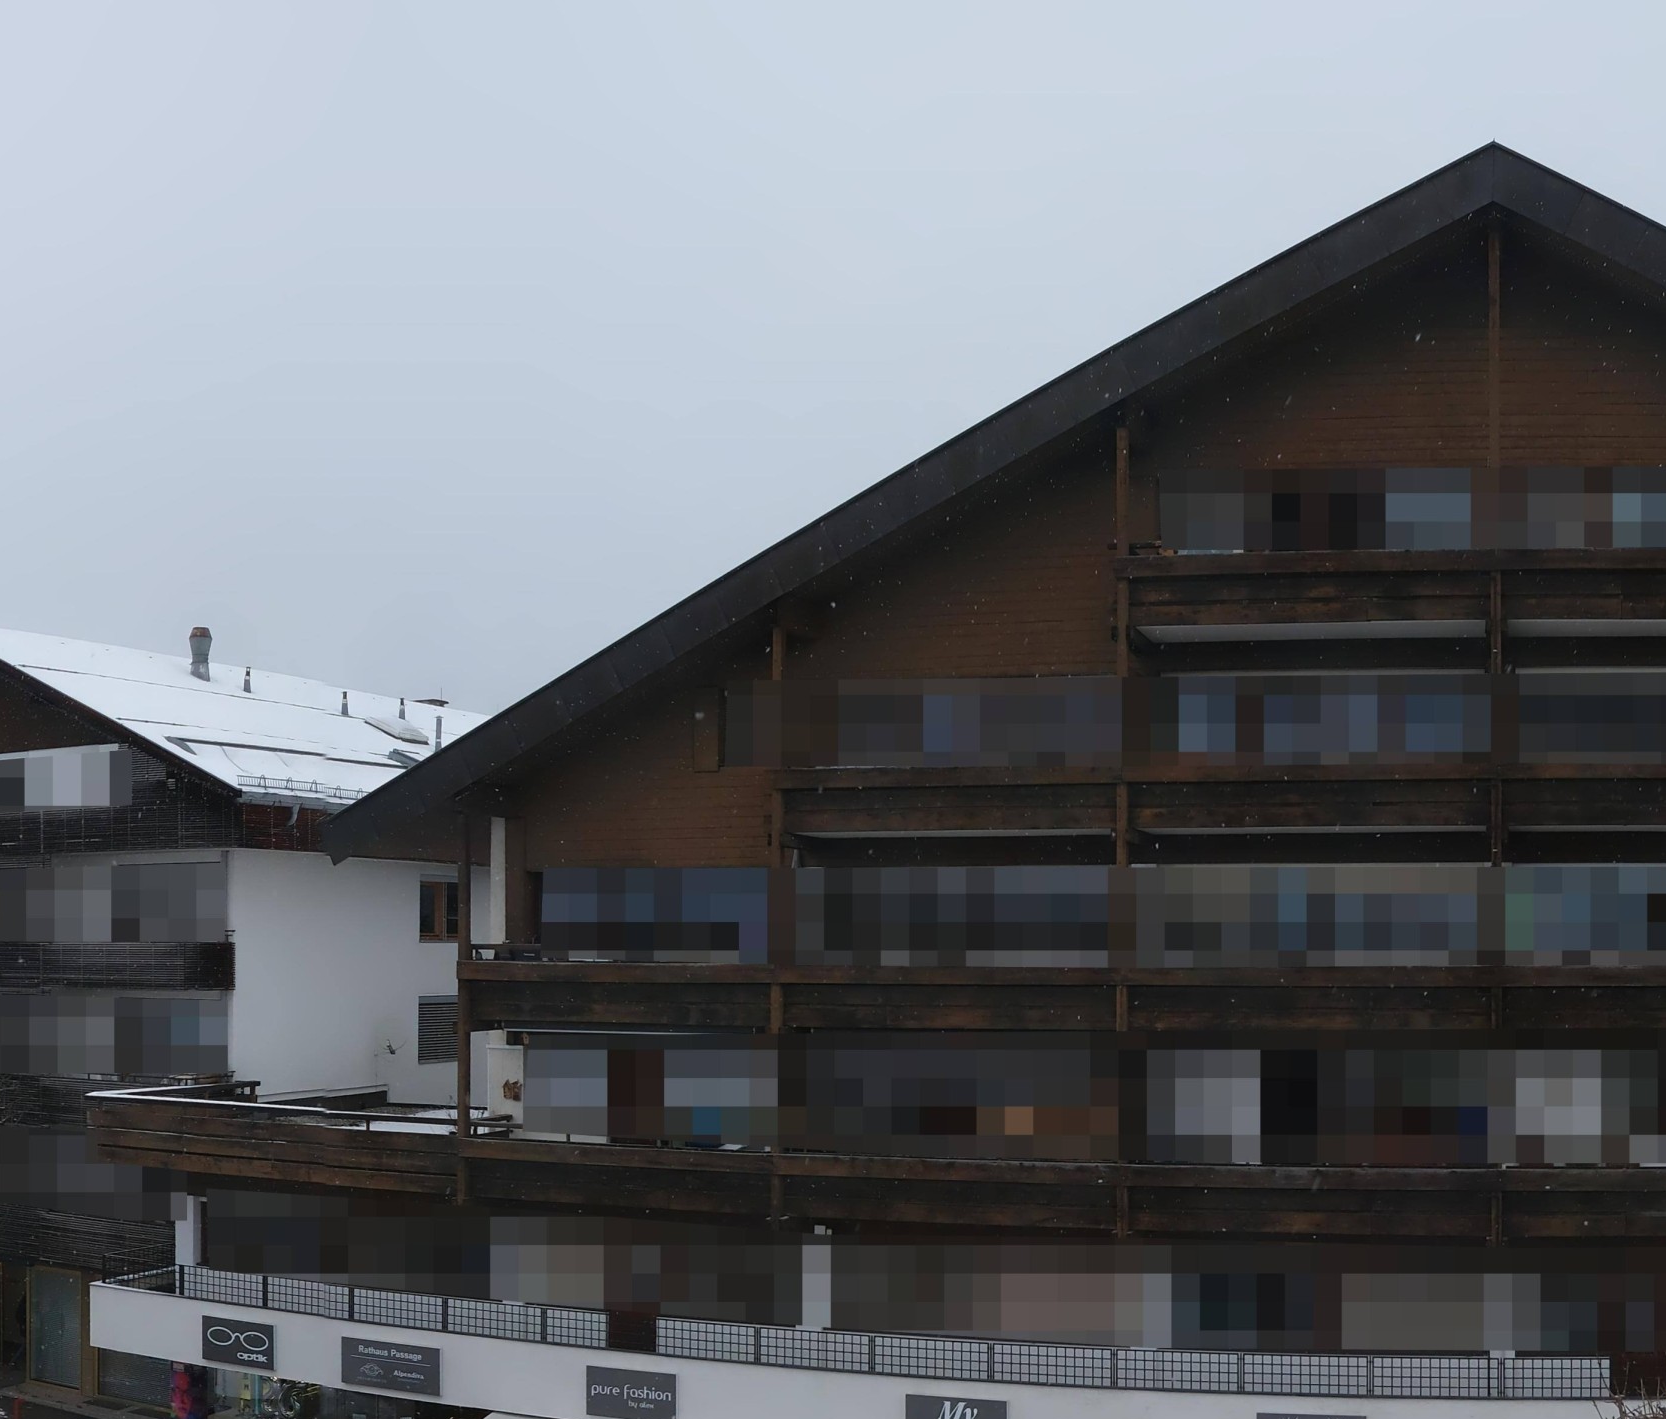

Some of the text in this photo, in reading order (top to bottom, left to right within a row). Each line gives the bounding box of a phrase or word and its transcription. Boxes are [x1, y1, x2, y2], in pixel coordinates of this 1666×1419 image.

[236, 1352, 268, 1363] optik
[358, 1344, 422, 1362] Rathaus Passage
[591, 1384, 672, 1402] pure fashion
[628, 1400, 638, 1409] by
